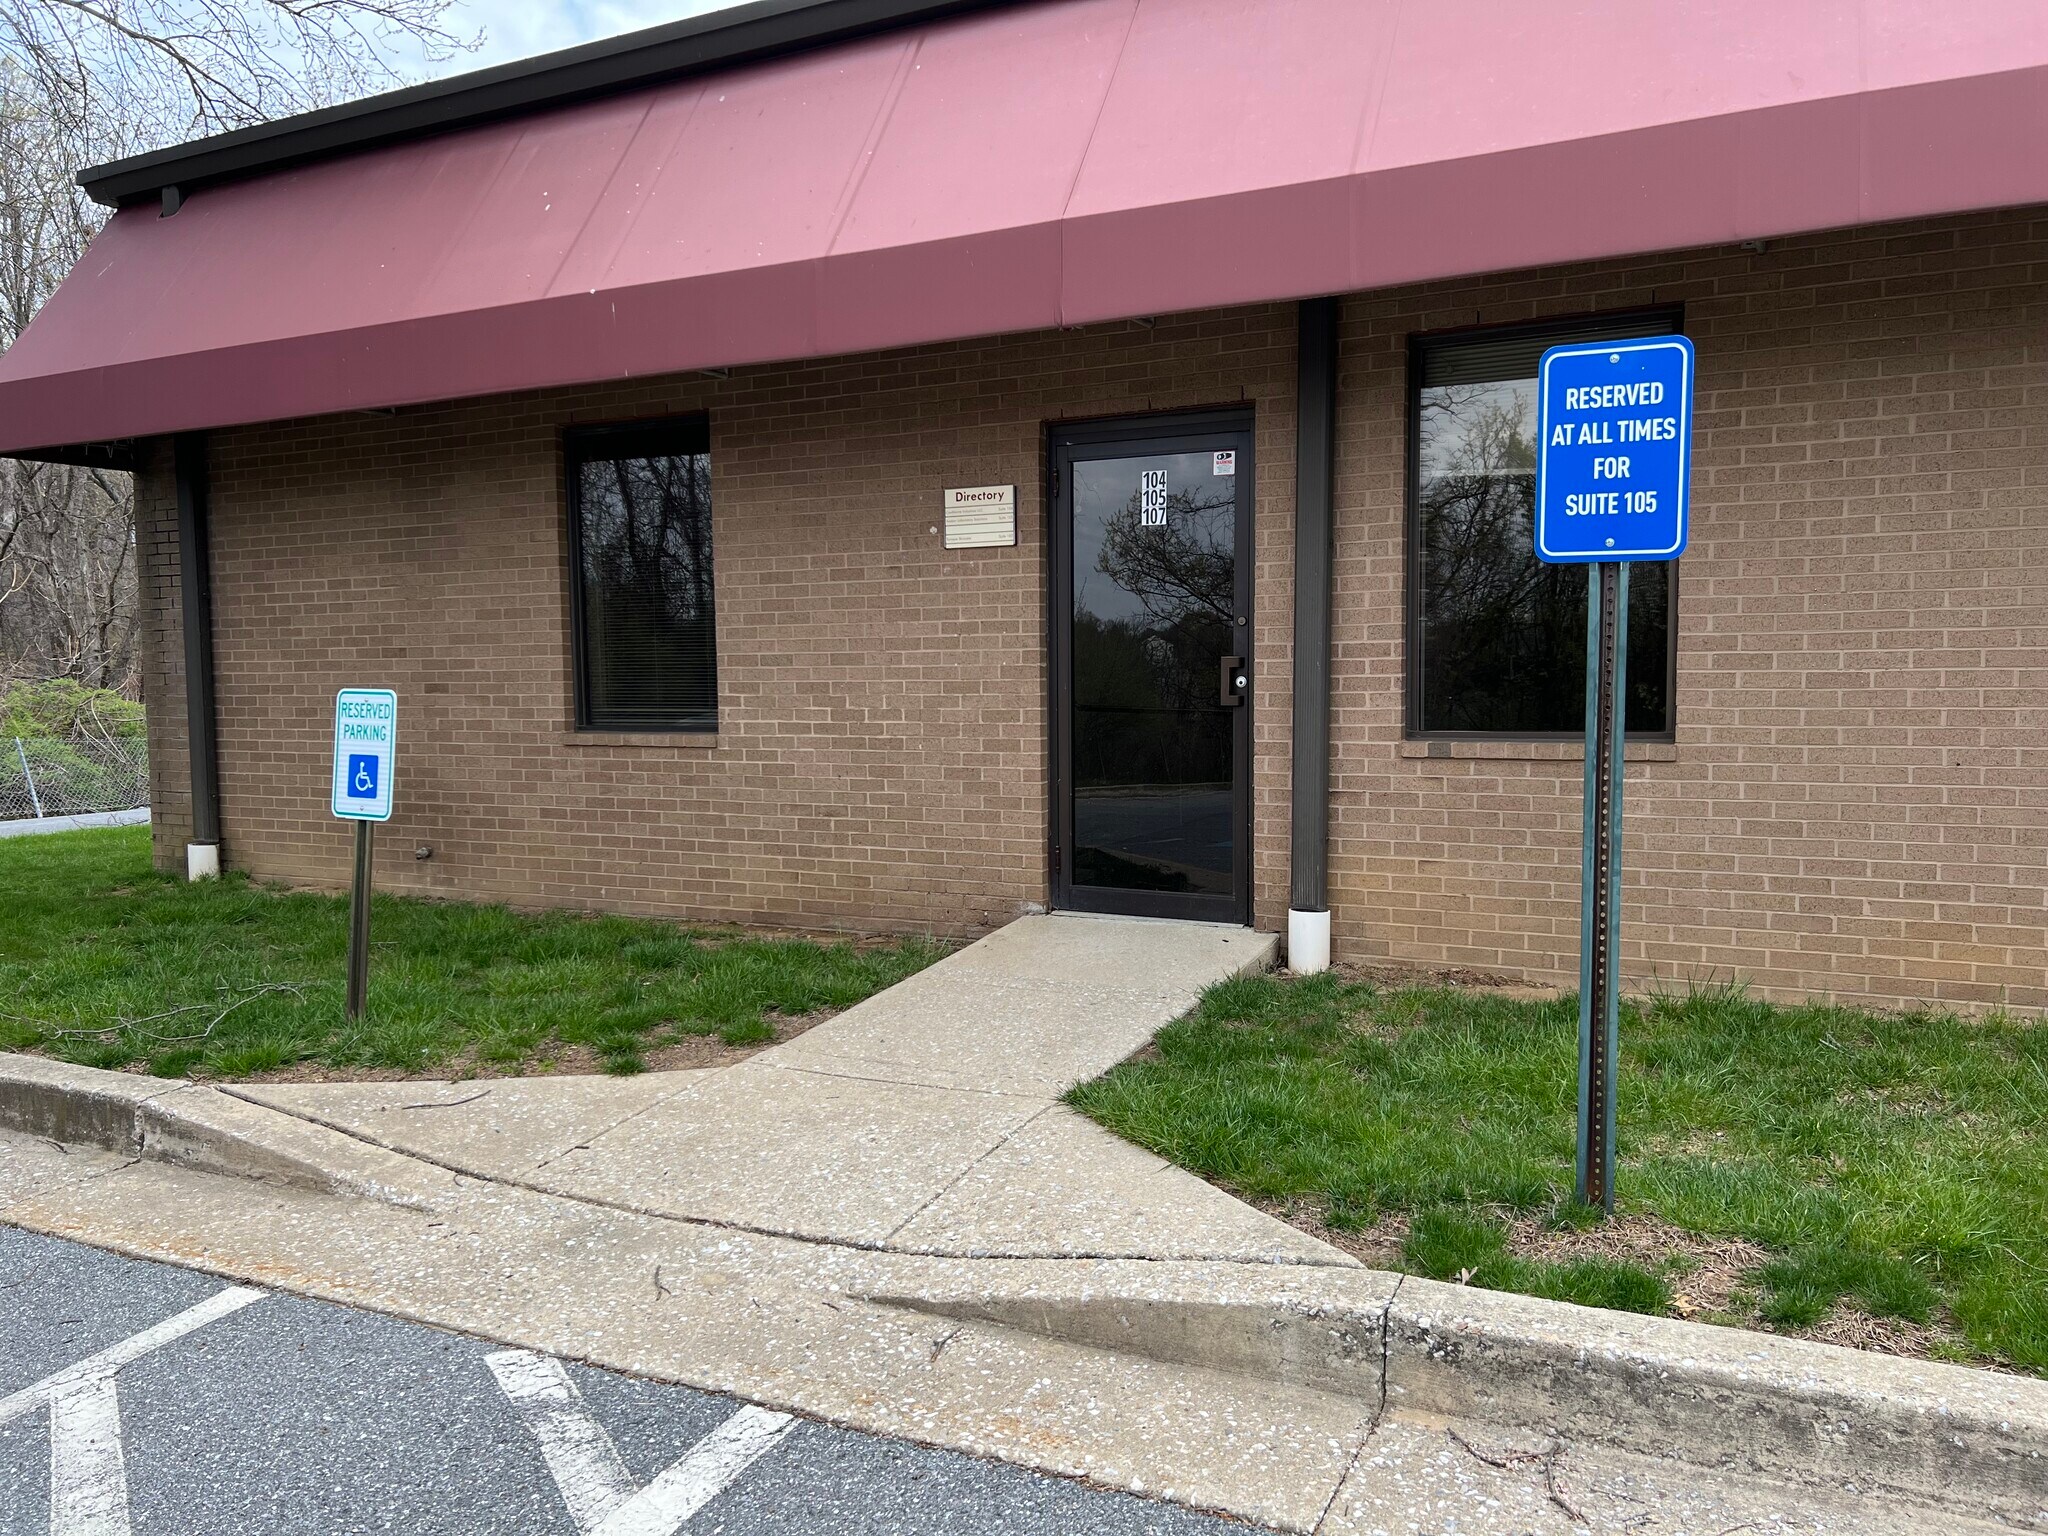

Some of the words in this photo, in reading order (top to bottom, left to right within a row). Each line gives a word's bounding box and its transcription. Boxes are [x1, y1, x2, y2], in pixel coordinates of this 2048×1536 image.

[1566, 381, 1664, 410] RESERVED
[1551, 423, 1575, 446] AT
[1577, 421, 1613, 445] ALL
[1617, 417, 1676, 443] TIMES
[1593, 456, 1630, 479] FOR
[1143, 471, 1166, 489] 104
[955, 491, 1005, 502] Directory
[1143, 489, 1166, 507] 105
[1565, 492, 1619, 516] SUITE
[1624, 491, 1657, 513] 105
[1143, 507, 1166, 525] 107
[341, 702, 391, 719] RESERVED
[343, 724, 387, 741] PARKING
